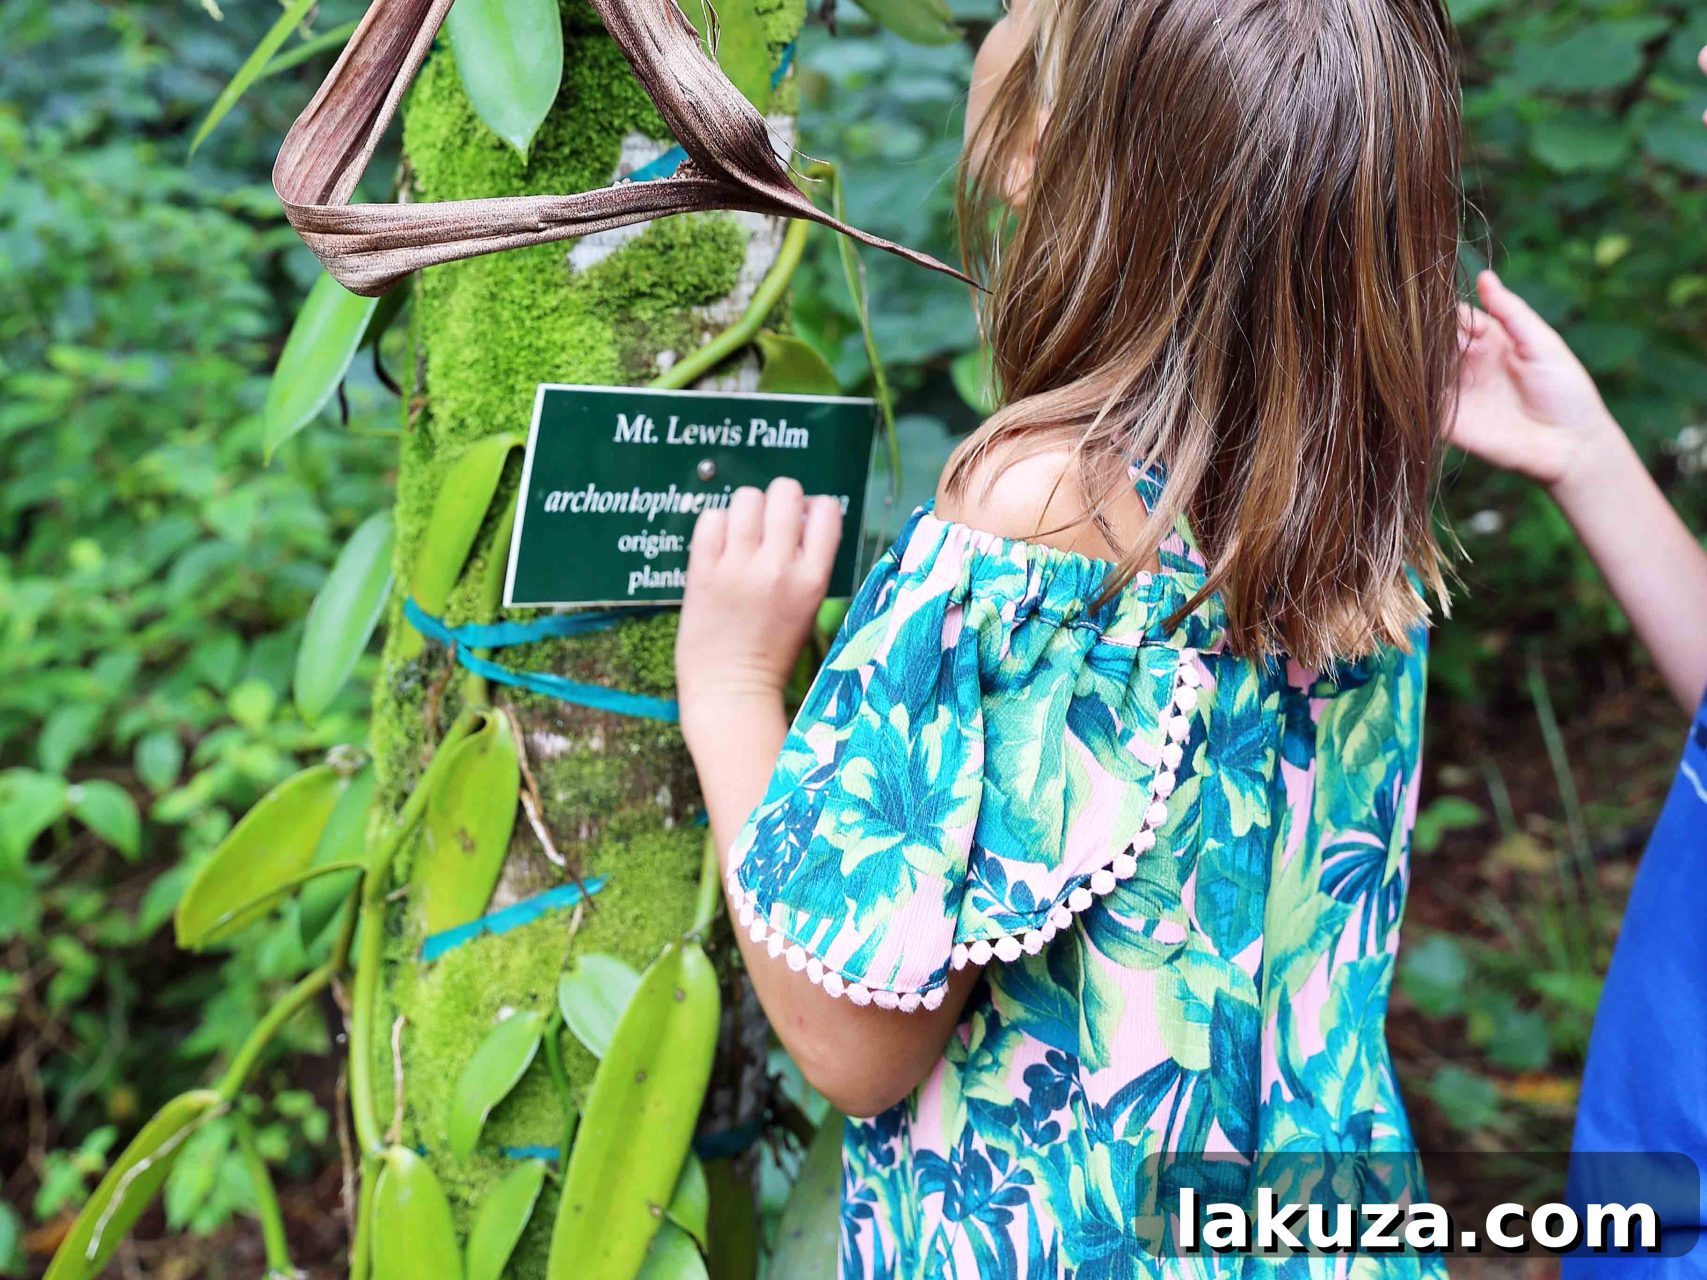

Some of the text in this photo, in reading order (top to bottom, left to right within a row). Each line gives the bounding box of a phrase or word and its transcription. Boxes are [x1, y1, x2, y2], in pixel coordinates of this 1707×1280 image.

[614, 413, 809, 449] Mt. Lewis Palm
[618, 531, 685, 559] origin:
